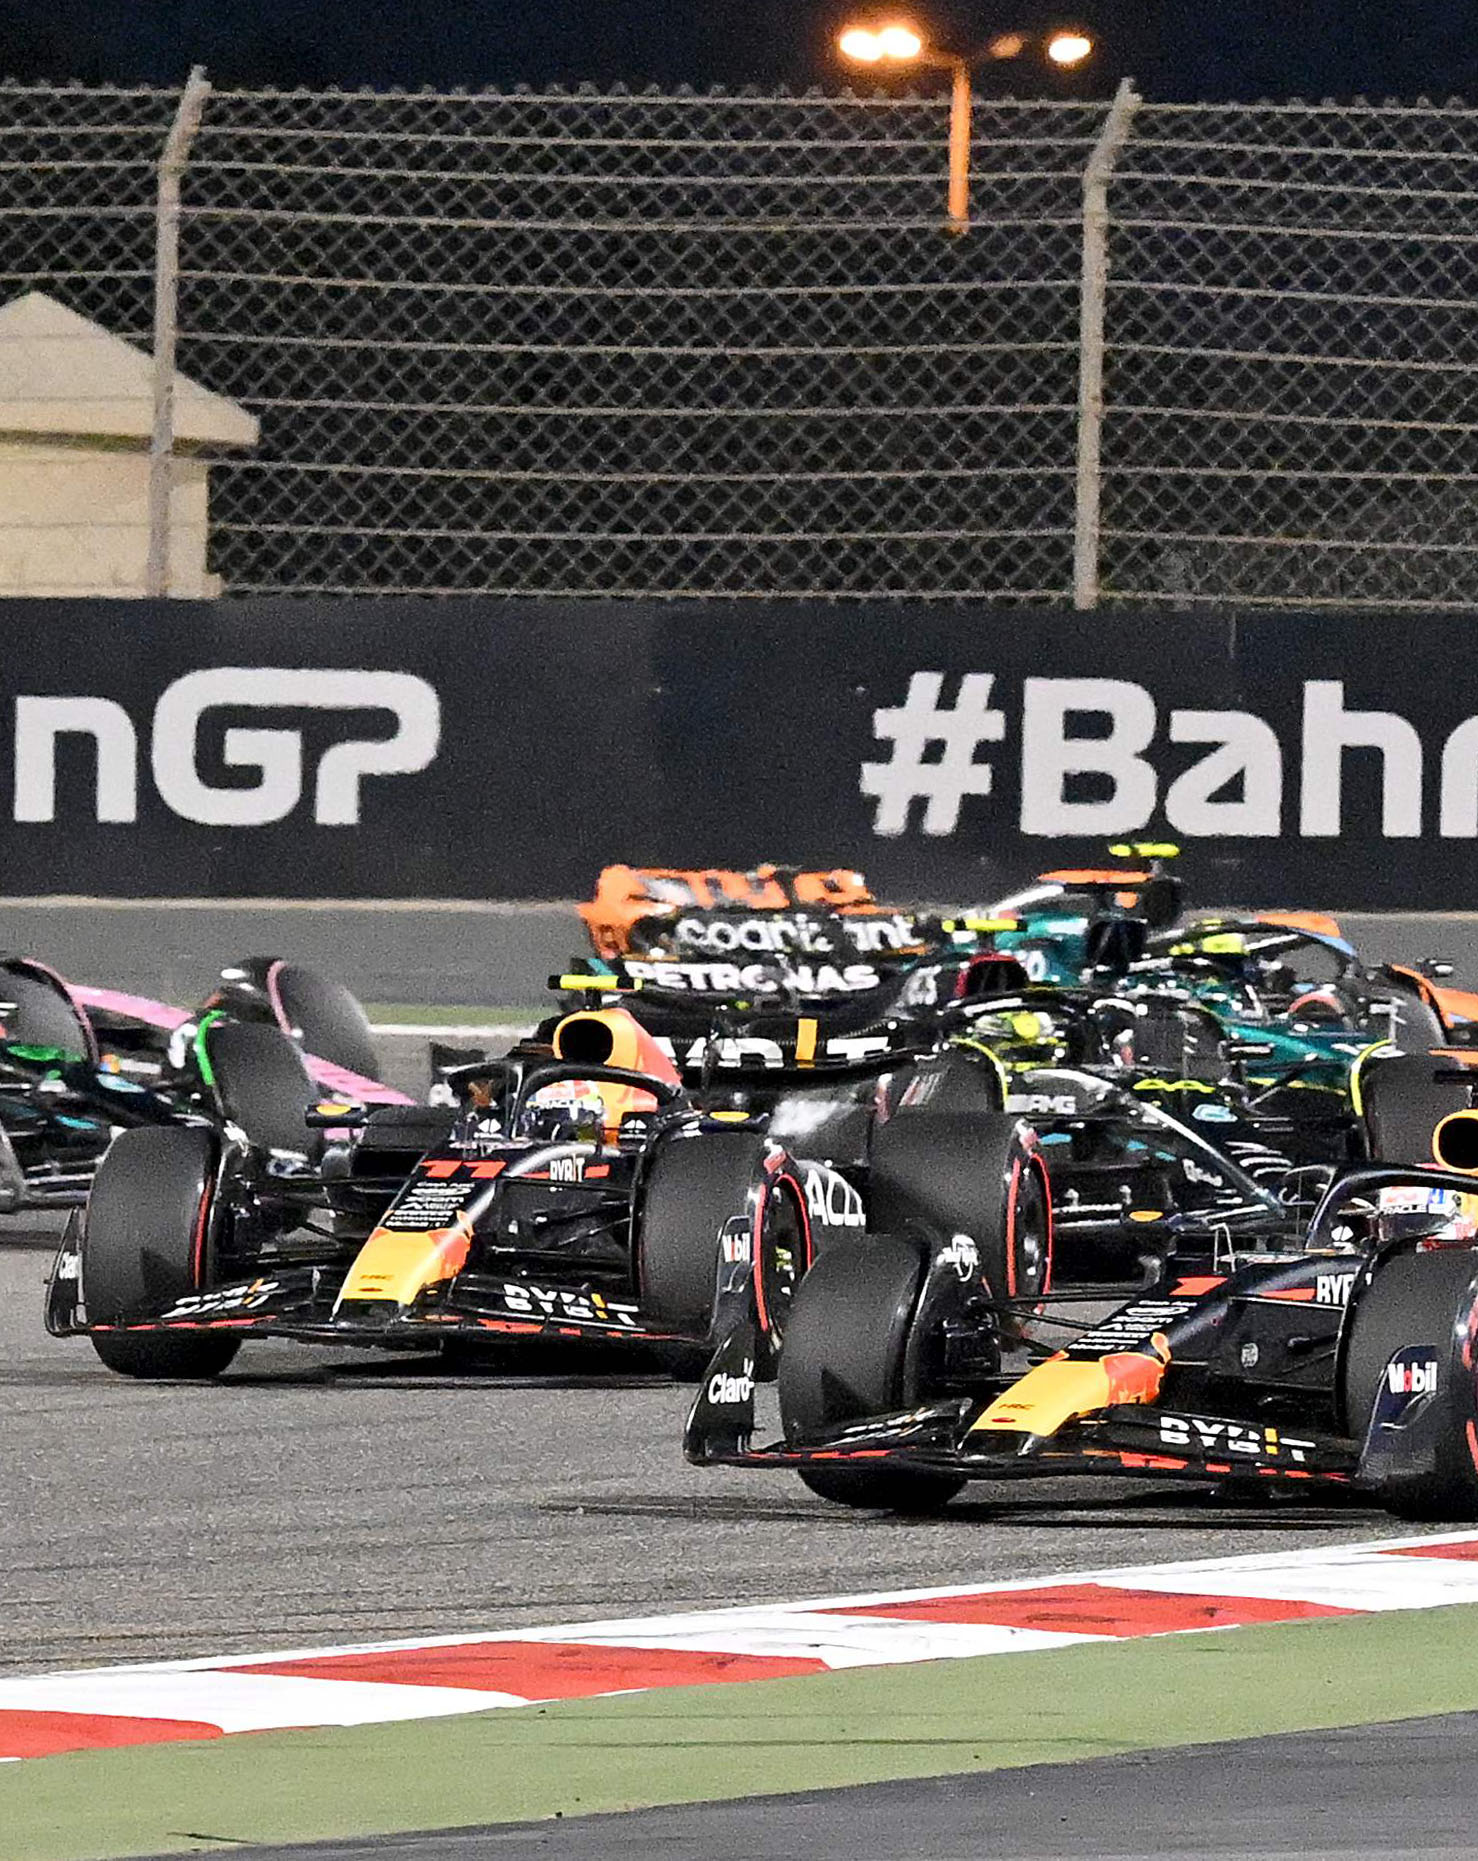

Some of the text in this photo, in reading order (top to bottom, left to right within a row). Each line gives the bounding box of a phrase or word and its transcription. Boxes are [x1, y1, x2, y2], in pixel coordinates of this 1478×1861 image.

[14, 666, 441, 828] nGP
[420, 1160, 507, 1179] 11
[708, 1366, 755, 1404] Claro
[1386, 1361, 1438, 1394] Mobil
